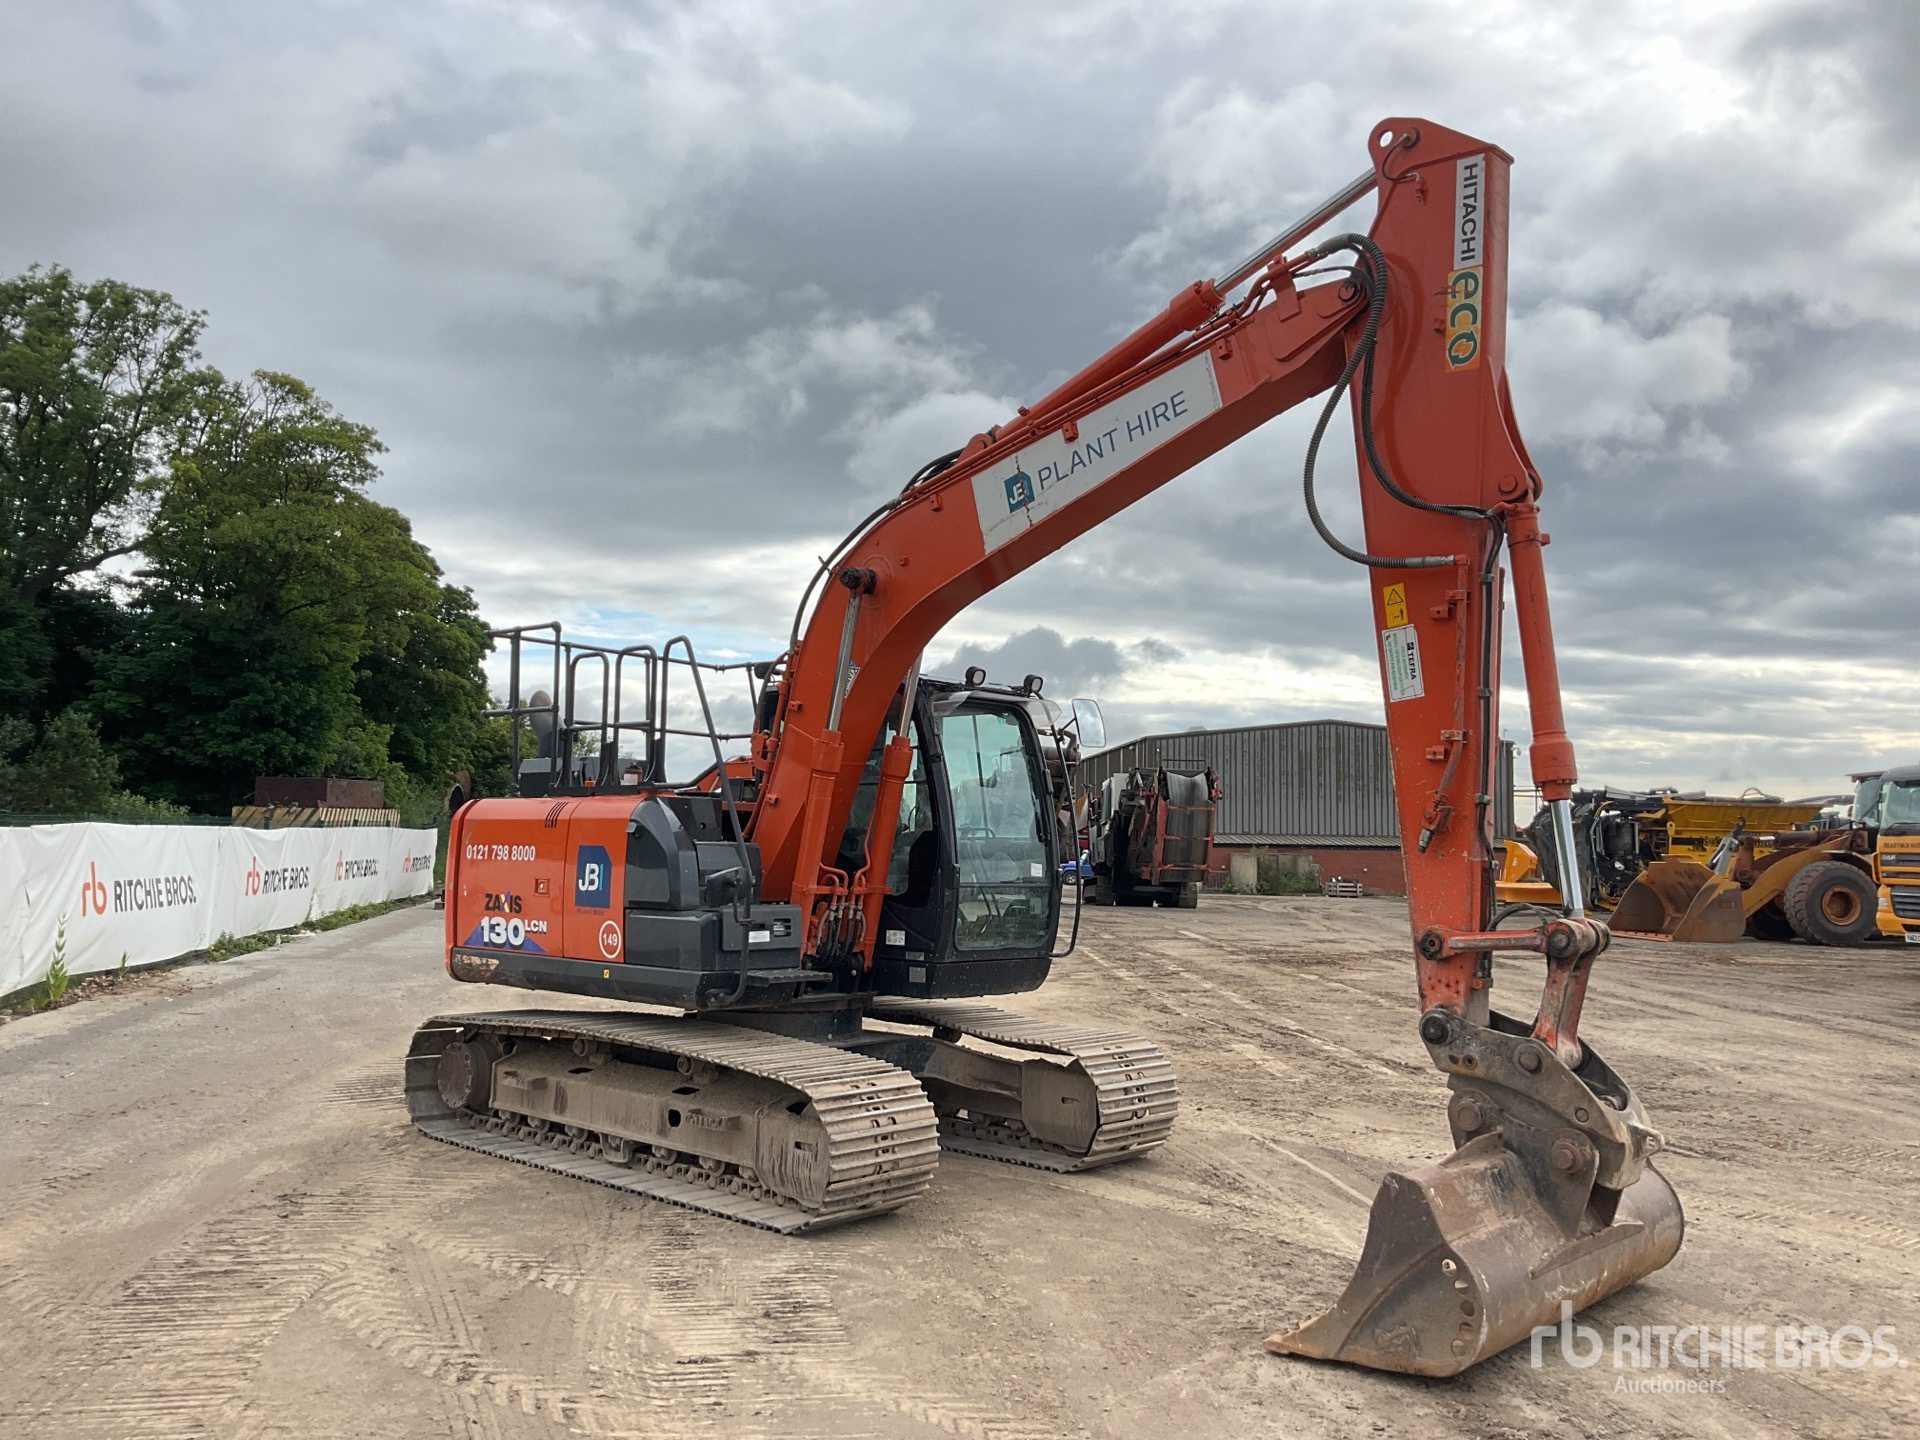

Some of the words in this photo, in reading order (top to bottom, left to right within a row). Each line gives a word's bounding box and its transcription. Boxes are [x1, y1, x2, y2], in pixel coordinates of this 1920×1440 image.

[1461, 163, 1478, 262] HITACHI
[1037, 427, 1119, 490] PLANT
[1125, 390, 1189, 442] HIRE
[1407, 651, 1417, 680] TEFRA
[466, 844, 489, 860] 0121
[491, 845, 510, 860] 798
[511, 845, 536, 861] 8000
[81, 861, 107, 917] rb
[113, 877, 164, 913] RITCHIE
[164, 875, 197, 907] BROS.
[245, 855, 261, 896] rb
[484, 890, 523, 914] ZAXIS
[481, 916, 525, 949] 130
[603, 933, 618, 946] 149
